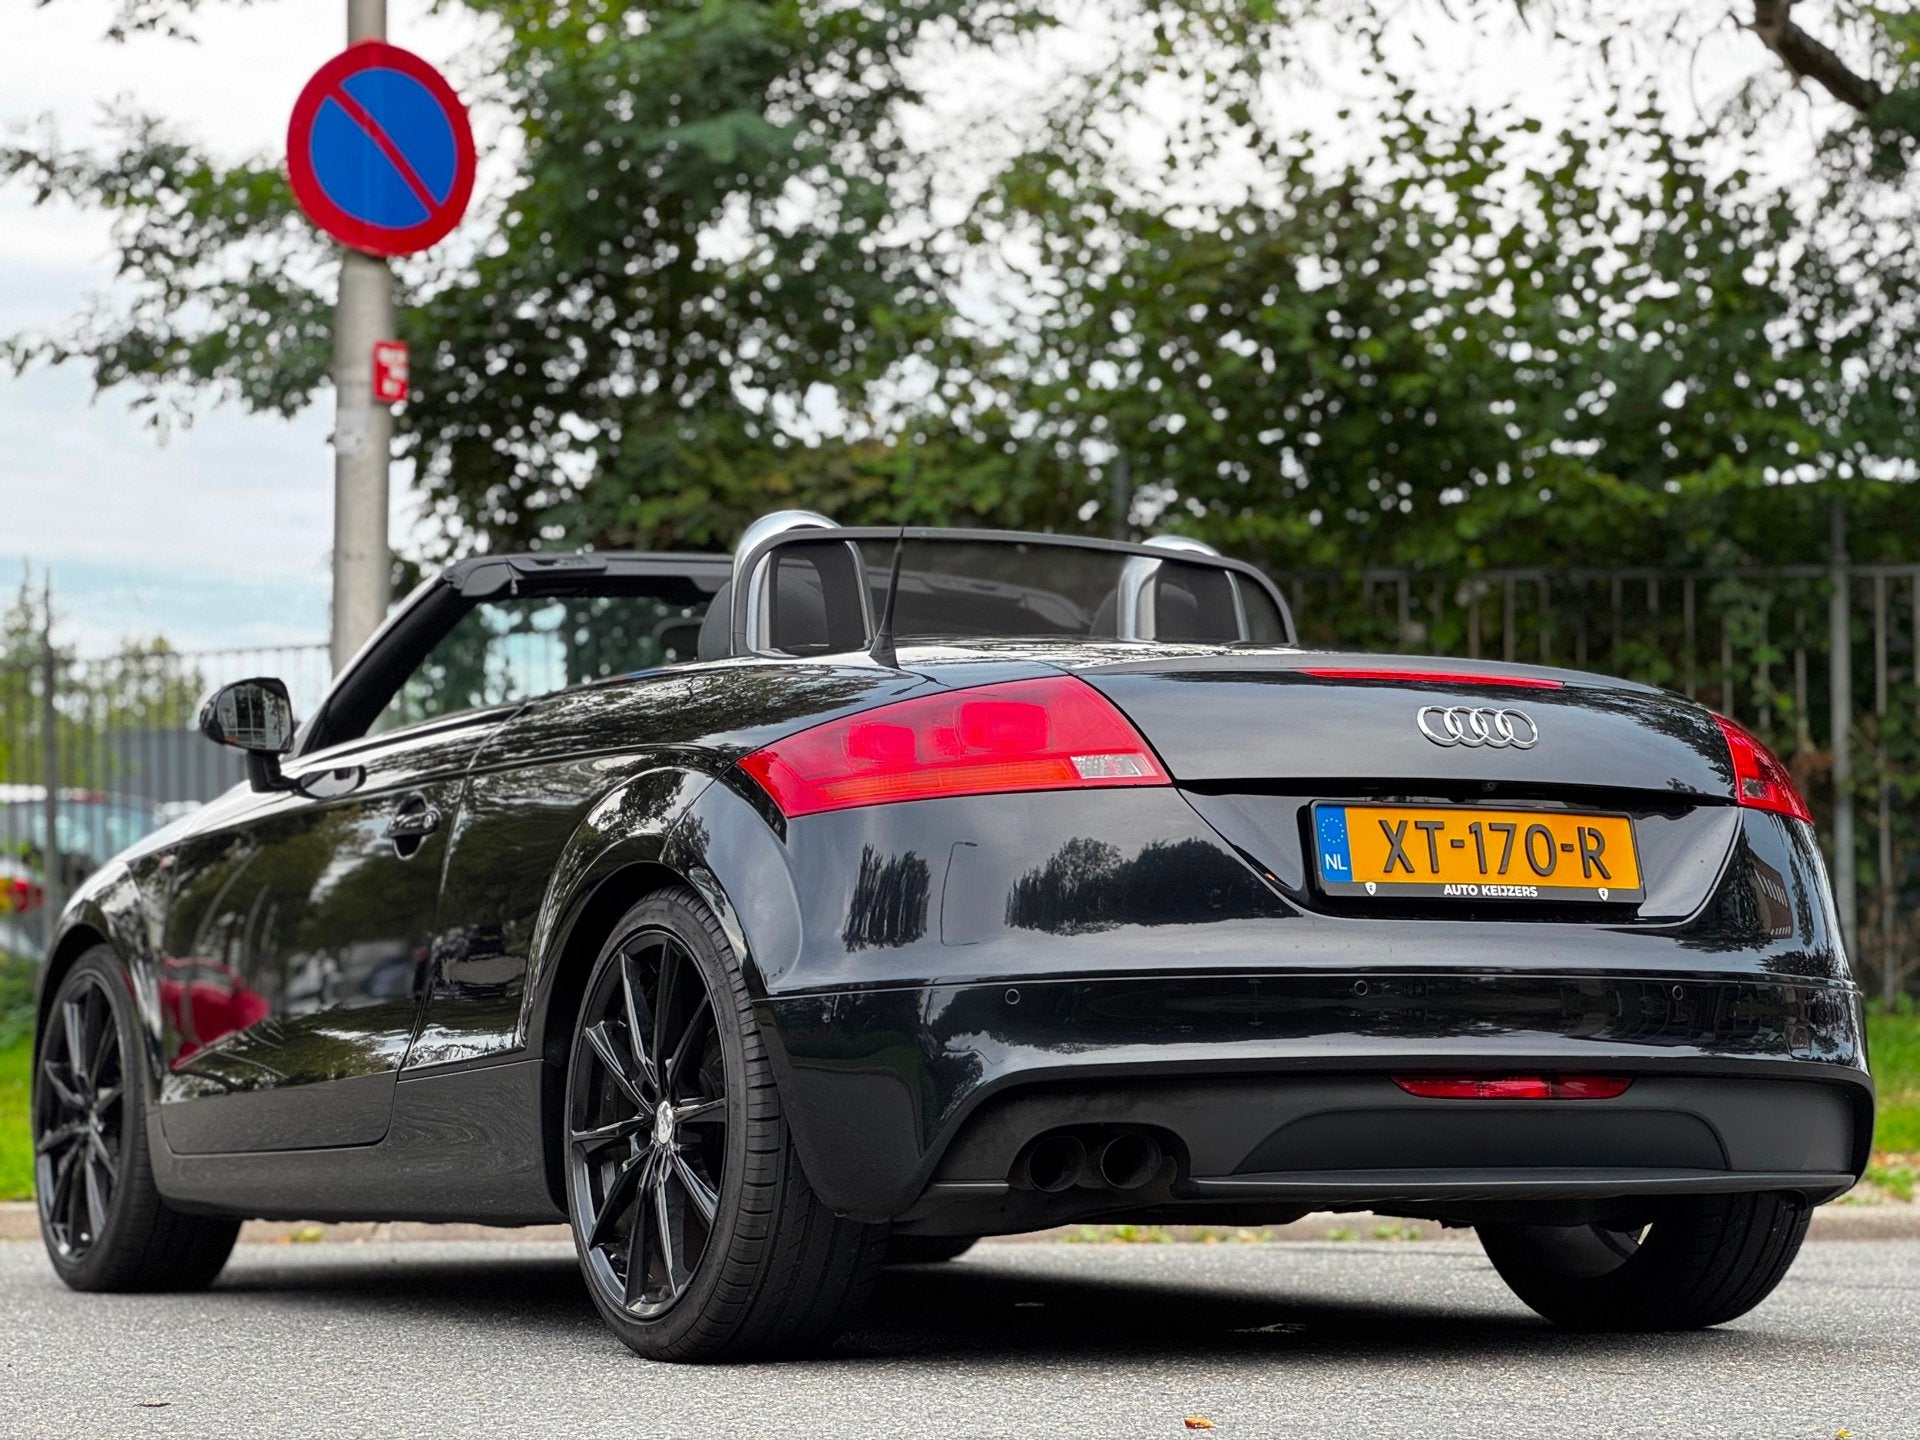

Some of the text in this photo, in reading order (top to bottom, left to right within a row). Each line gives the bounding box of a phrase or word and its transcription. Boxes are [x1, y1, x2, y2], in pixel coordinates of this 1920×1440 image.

[1378, 819, 1612, 880] XT-170-R
[1324, 853, 1348, 871] NL
[1443, 884, 1539, 898] AUTO KEIJZERS
